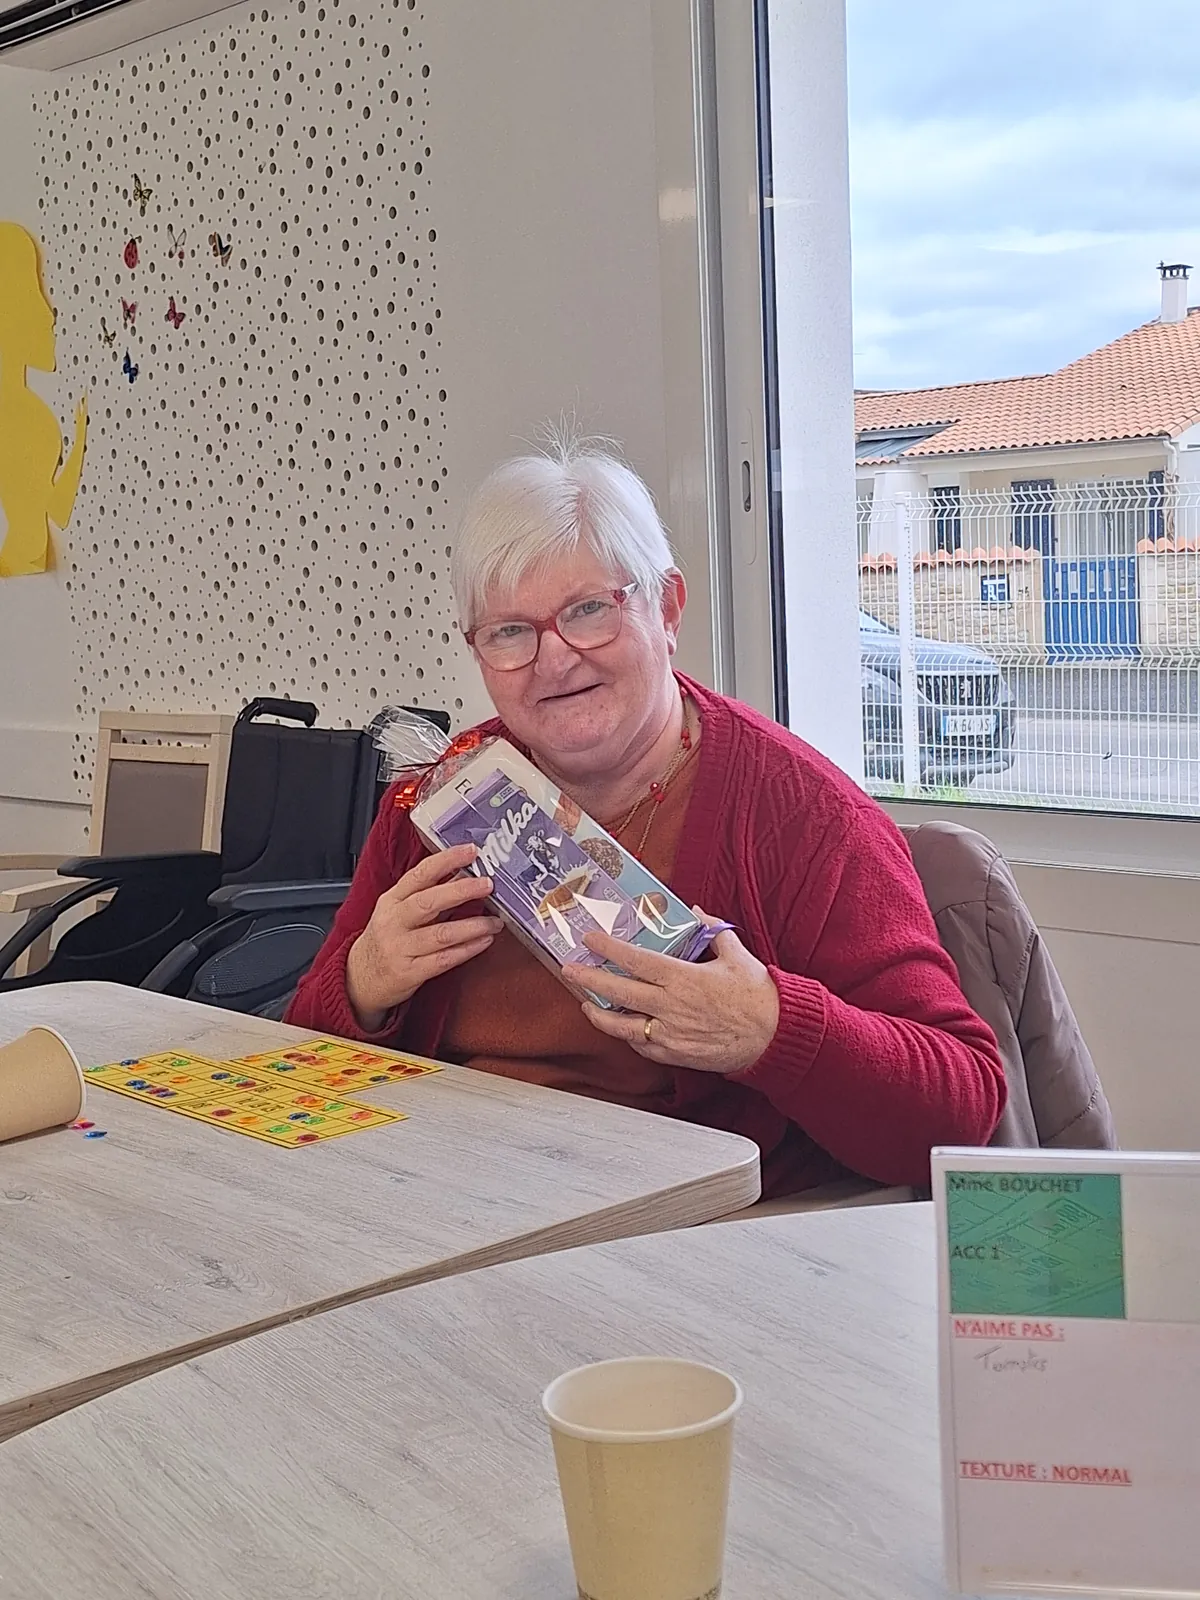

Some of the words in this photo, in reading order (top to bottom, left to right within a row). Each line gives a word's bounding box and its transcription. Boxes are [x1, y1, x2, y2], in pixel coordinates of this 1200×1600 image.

[470, 801, 539, 878] Milka
[950, 1178, 993, 1192] Mme
[999, 1177, 1083, 1193] BOUCHET
[951, 1245, 986, 1259] ACC
[954, 1320, 1016, 1337] N'AIME
[1022, 1322, 1054, 1338] PAS
[960, 1461, 1037, 1478] TEXTURE
[1052, 1466, 1132, 1483] NORMAL
